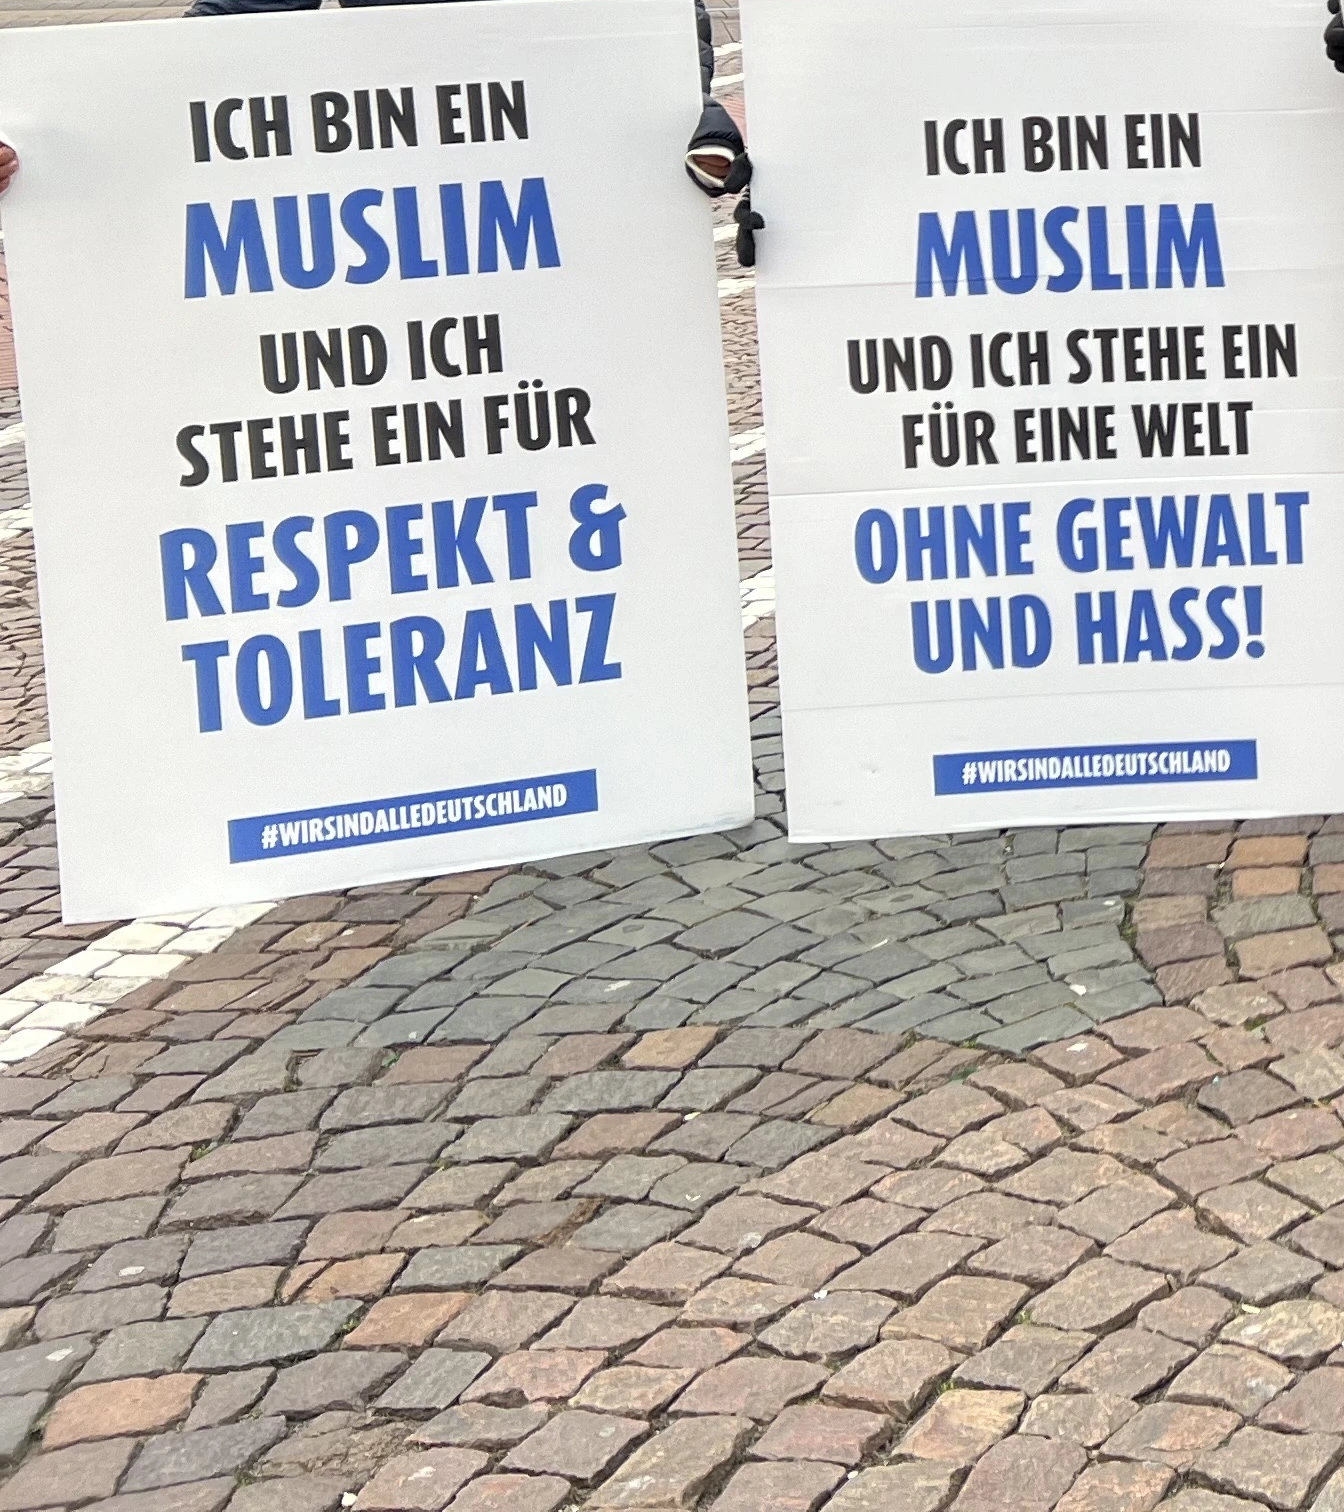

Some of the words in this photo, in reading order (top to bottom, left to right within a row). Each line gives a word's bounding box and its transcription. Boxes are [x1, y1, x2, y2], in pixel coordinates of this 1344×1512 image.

[190, 96, 292, 162] ICH
[311, 87, 417, 153] BIN
[436, 81, 528, 144] EIN
[925, 118, 1005, 175] ICH
[1022, 115, 1108, 172] BIN
[1125, 113, 1201, 169] EIN
[185, 178, 560, 298] MUSLIM
[916, 204, 1224, 297] MUSLIM
[260, 325, 387, 394] UND
[407, 314, 503, 380] ICH
[848, 336, 952, 394] UND
[970, 331, 1050, 388] ICH
[1067, 326, 1206, 384] STEHE
[1222, 324, 1297, 378] EIN
[177, 410, 353, 486] STEHE
[372, 399, 465, 466] EIN
[484, 379, 596, 454] FÜR
[903, 401, 998, 468] FÜR
[1014, 406, 1117, 463] EINE
[1132, 402, 1253, 457] WELT
[160, 491, 537, 620] RESPEKT
[569, 484, 626, 571] &
[856, 502, 1033, 583] OHNE
[1057, 492, 1309, 572] GEWALT
[182, 593, 621, 732] TOLERANZ
[912, 595, 1051, 673] UND
[1076, 586, 1264, 664] HASS!
[962, 749, 1230, 785] #WIRSINDALLEDEUTSCHLAND
[262, 784, 567, 849] #WIRSINDALLEDEUTSCHLAND
